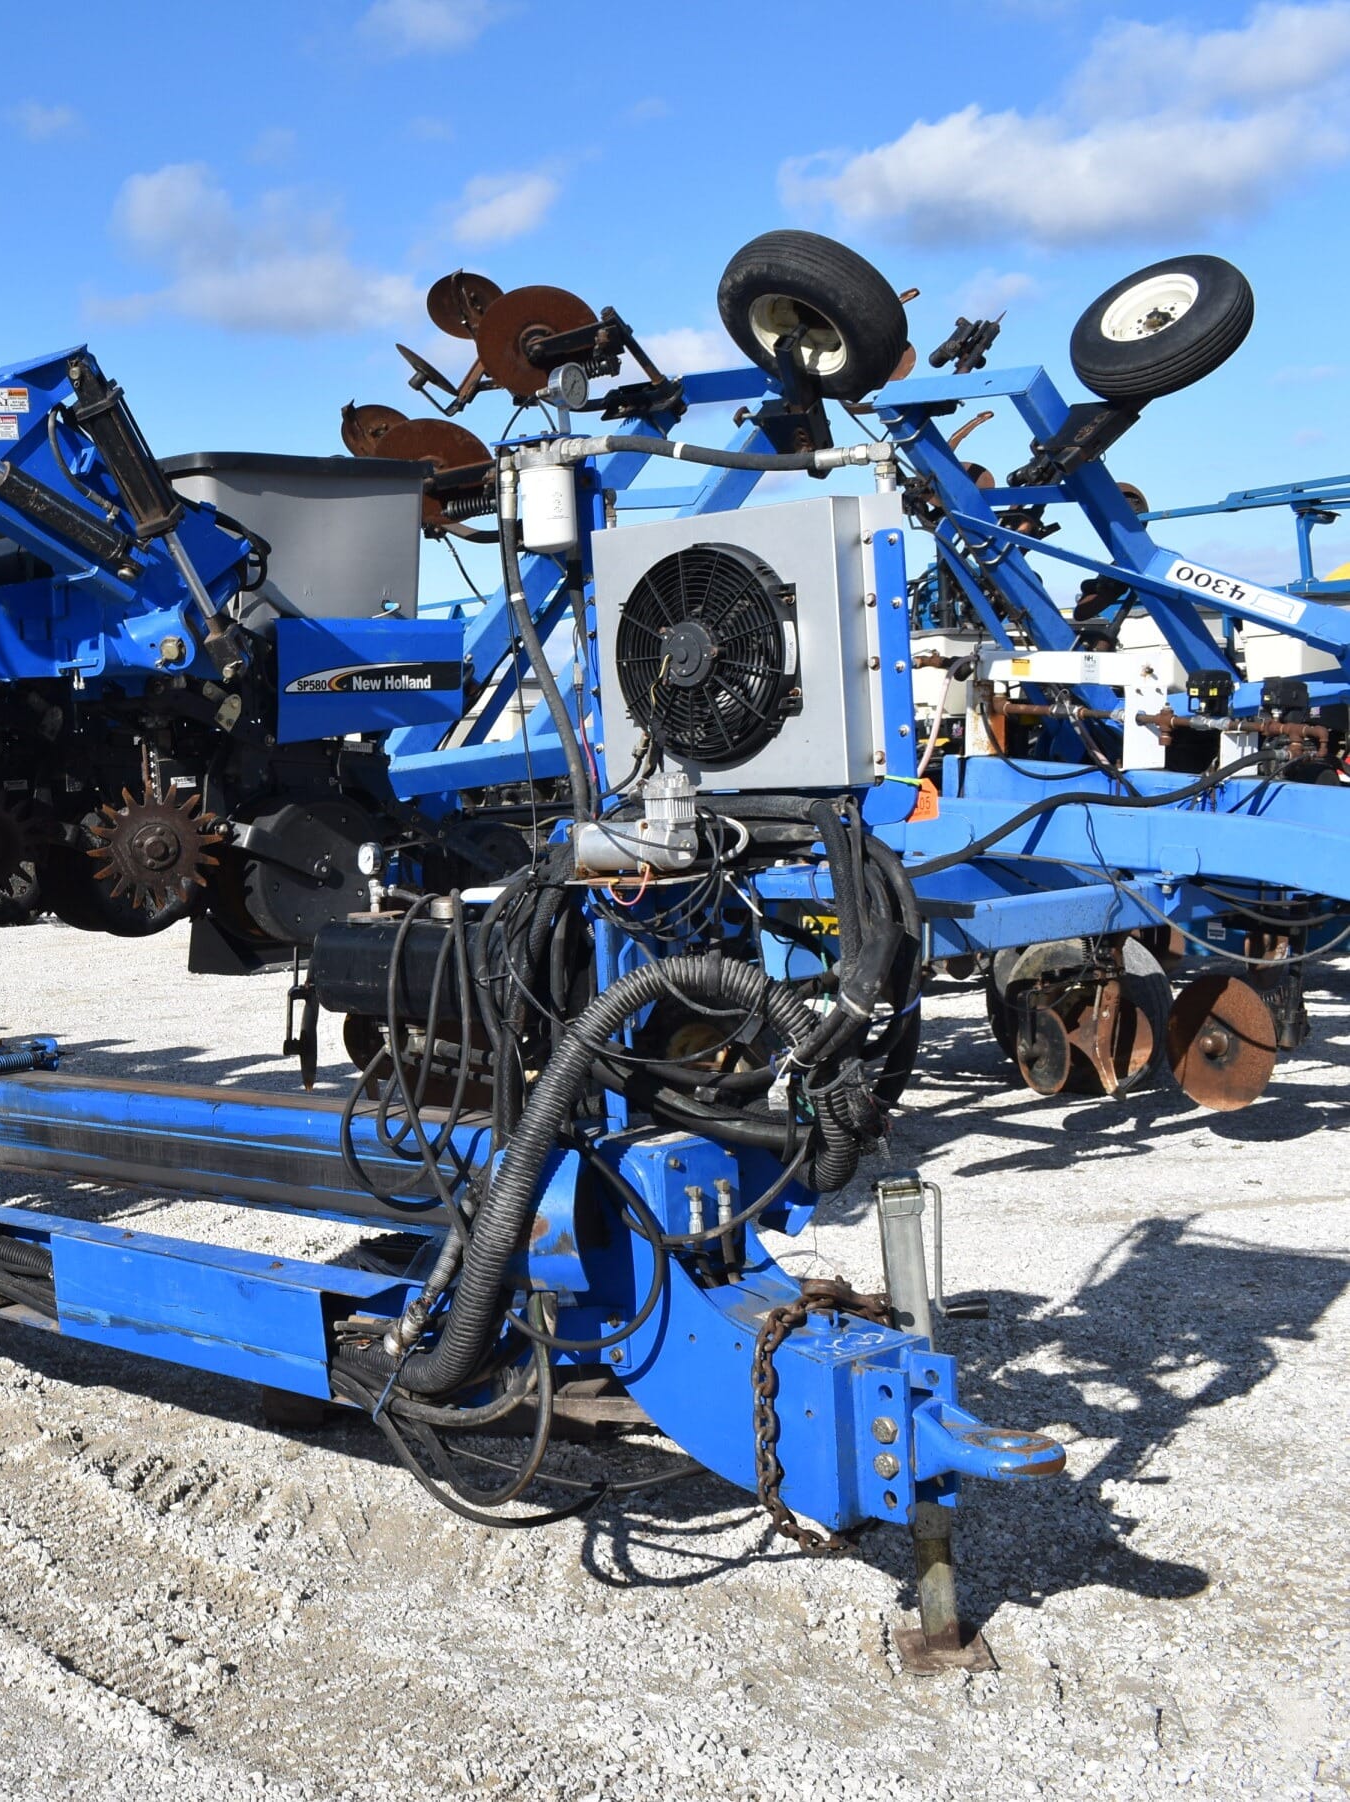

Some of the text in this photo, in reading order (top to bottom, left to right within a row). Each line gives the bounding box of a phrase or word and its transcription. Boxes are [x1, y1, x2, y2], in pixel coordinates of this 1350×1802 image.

[1176, 566, 1246, 600] 4300
[297, 674, 432, 691] SP580 New Holland
